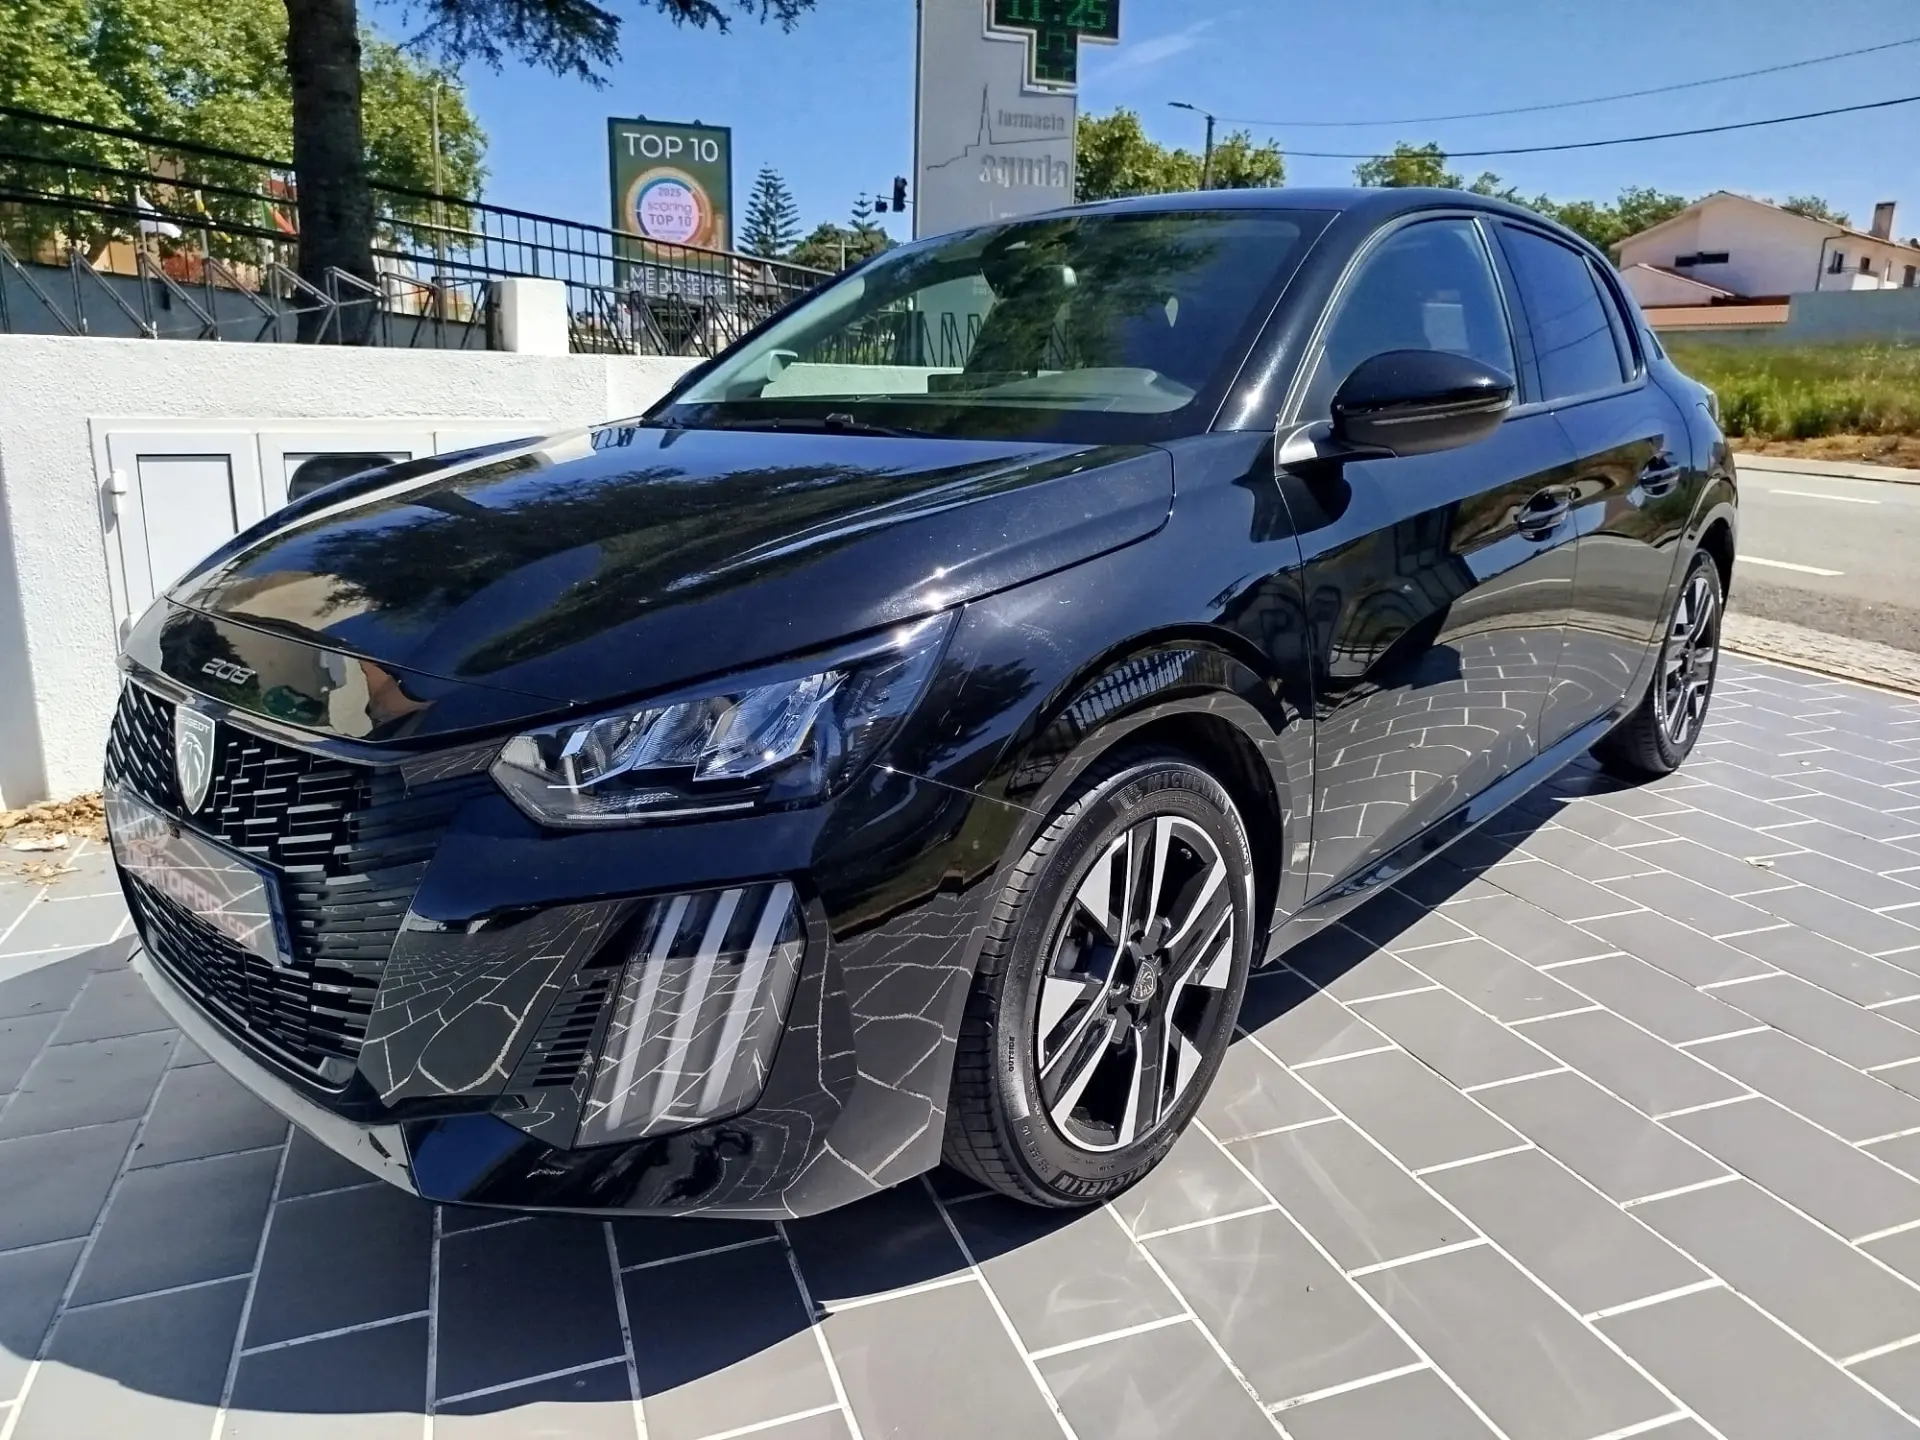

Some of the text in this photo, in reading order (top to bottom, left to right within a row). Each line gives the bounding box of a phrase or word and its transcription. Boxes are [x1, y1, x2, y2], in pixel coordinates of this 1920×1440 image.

[622, 133, 719, 162] TOP 10
[658, 187, 682, 198] 2025
[647, 201, 693, 216] scoring
[648, 213, 692, 227] TOP 10
[201, 657, 256, 685] 208
[1008, 1035, 1016, 1072] OUTSIDE
